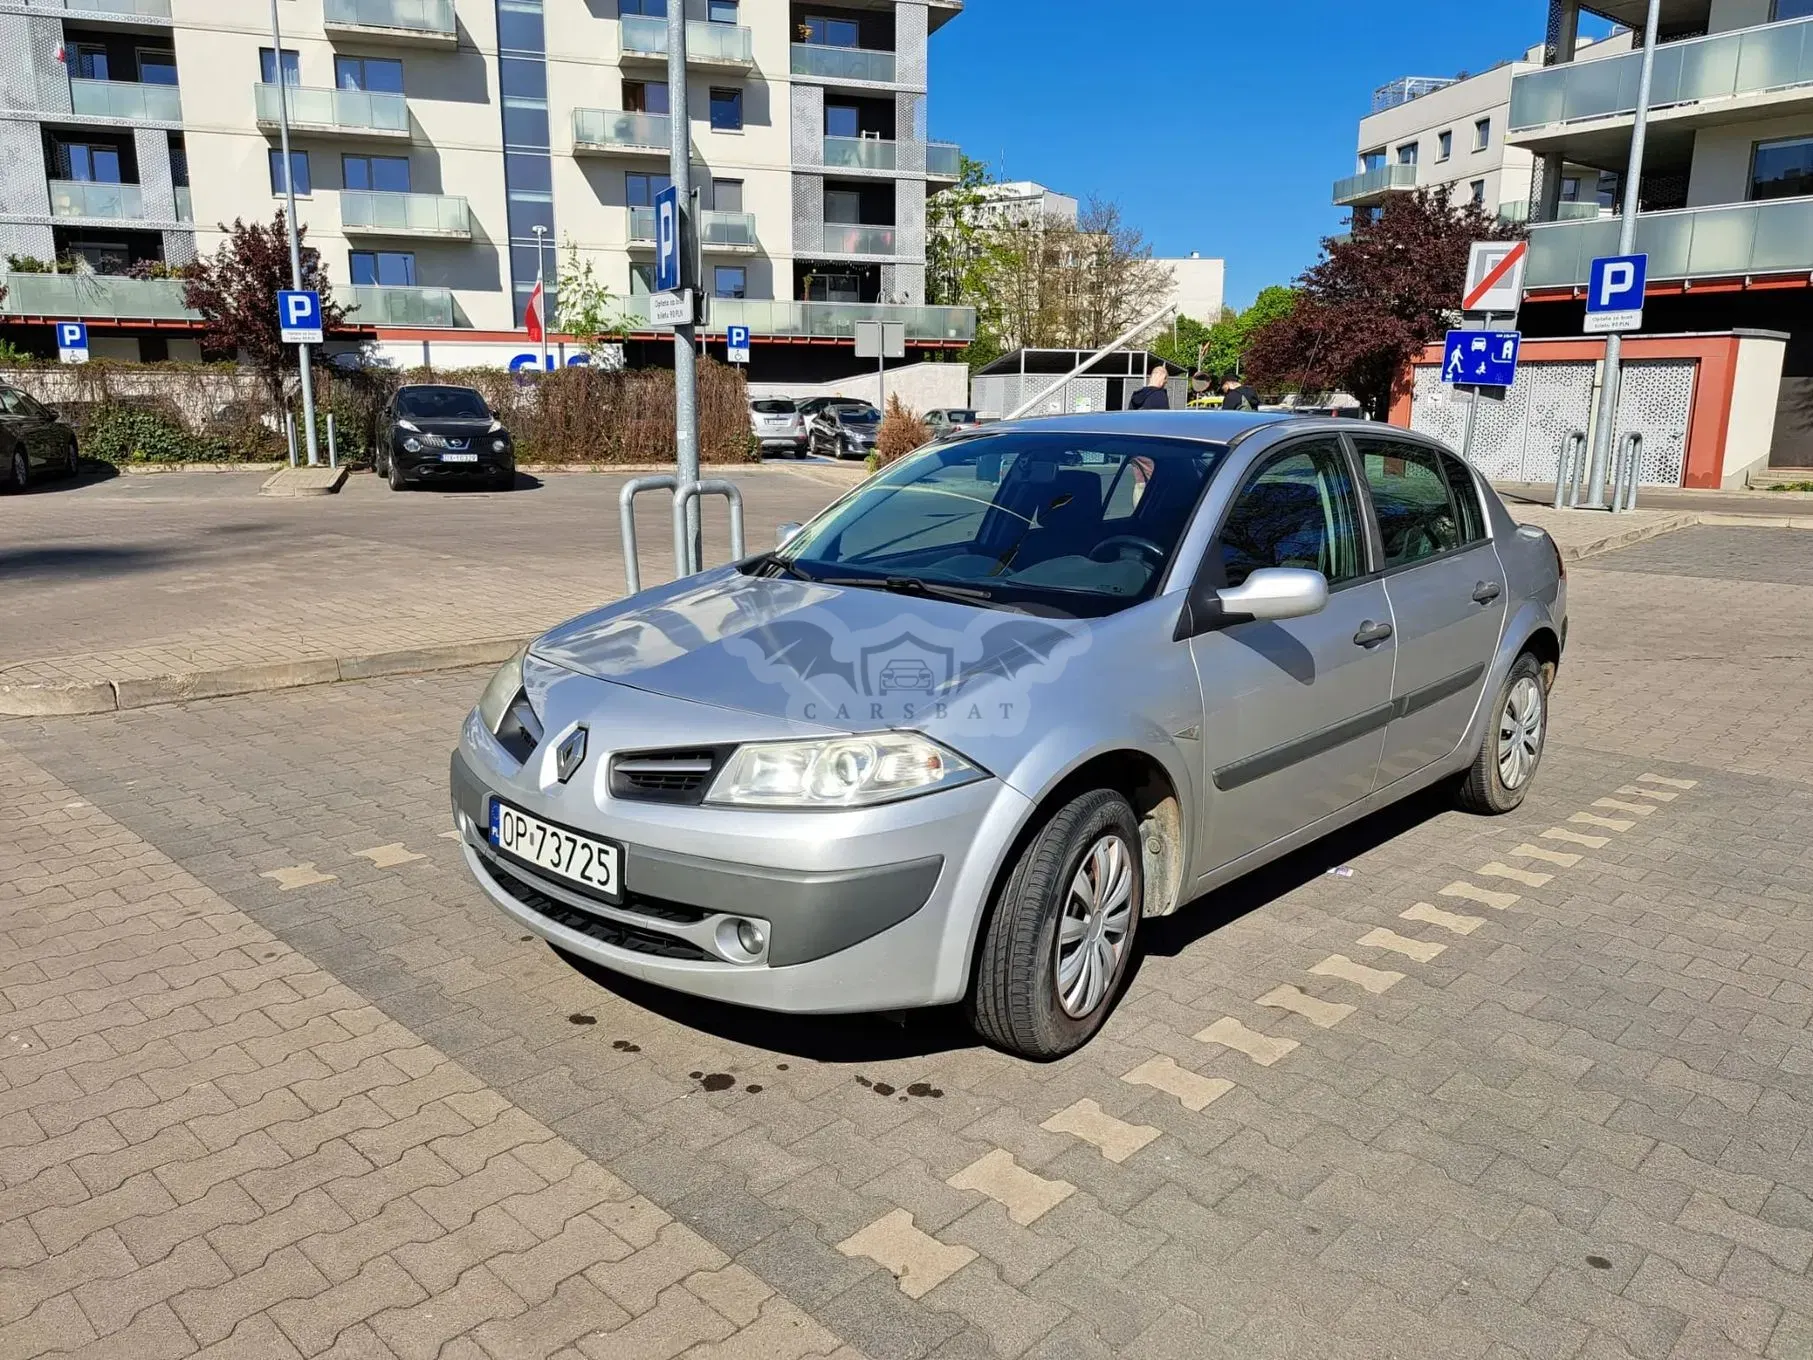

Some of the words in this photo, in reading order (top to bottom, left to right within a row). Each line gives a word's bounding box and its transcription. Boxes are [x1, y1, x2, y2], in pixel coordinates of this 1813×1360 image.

[660, 200, 673, 279] P
[1600, 262, 1635, 305] P
[288, 295, 311, 325] P
[63, 325, 81, 345] P
[733, 328, 745, 345] P
